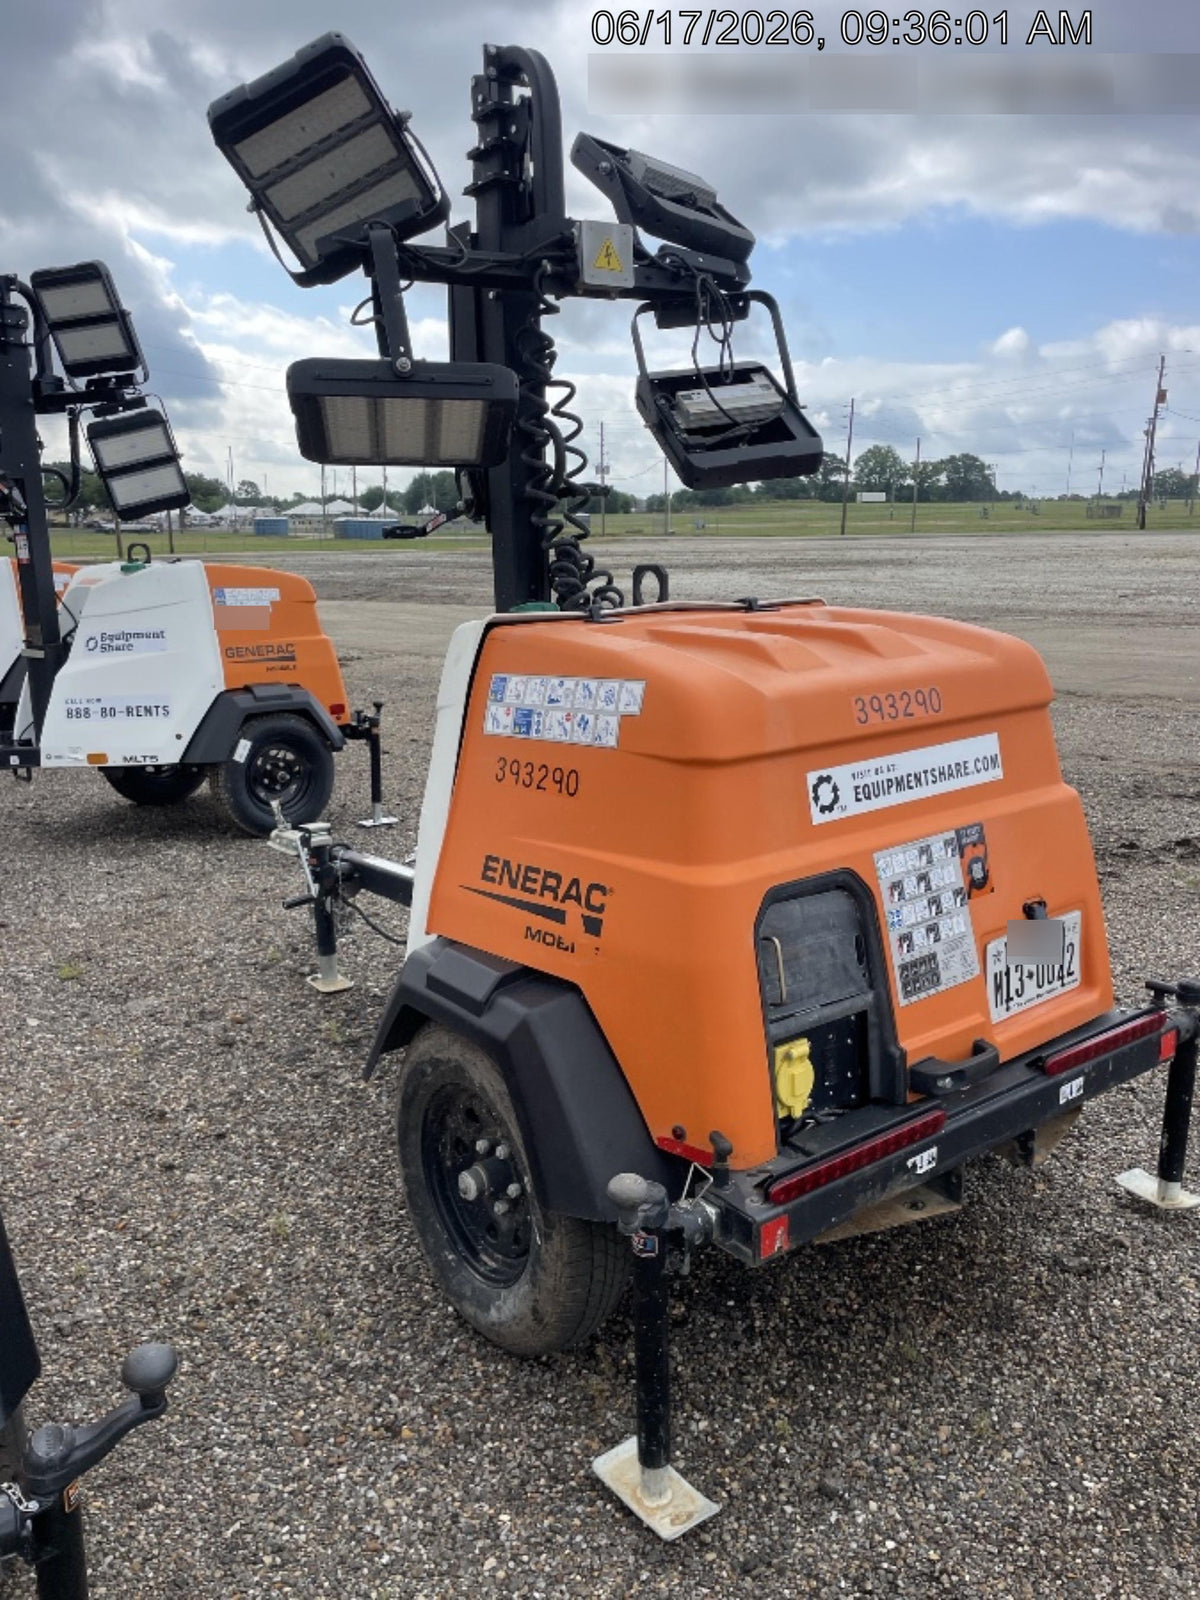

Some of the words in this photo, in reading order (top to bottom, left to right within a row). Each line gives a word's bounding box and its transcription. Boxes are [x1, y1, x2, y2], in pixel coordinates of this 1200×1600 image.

[100, 630, 166, 643] Equipment
[100, 643, 134, 653] Share
[225, 643, 295, 658] GENERAC
[66, 705, 170, 719] 888-80-RENTS
[854, 687, 943, 725] 393290
[494, 756, 580, 797] 393290
[853, 753, 1001, 803] EQUIPMENTSHARE.COM
